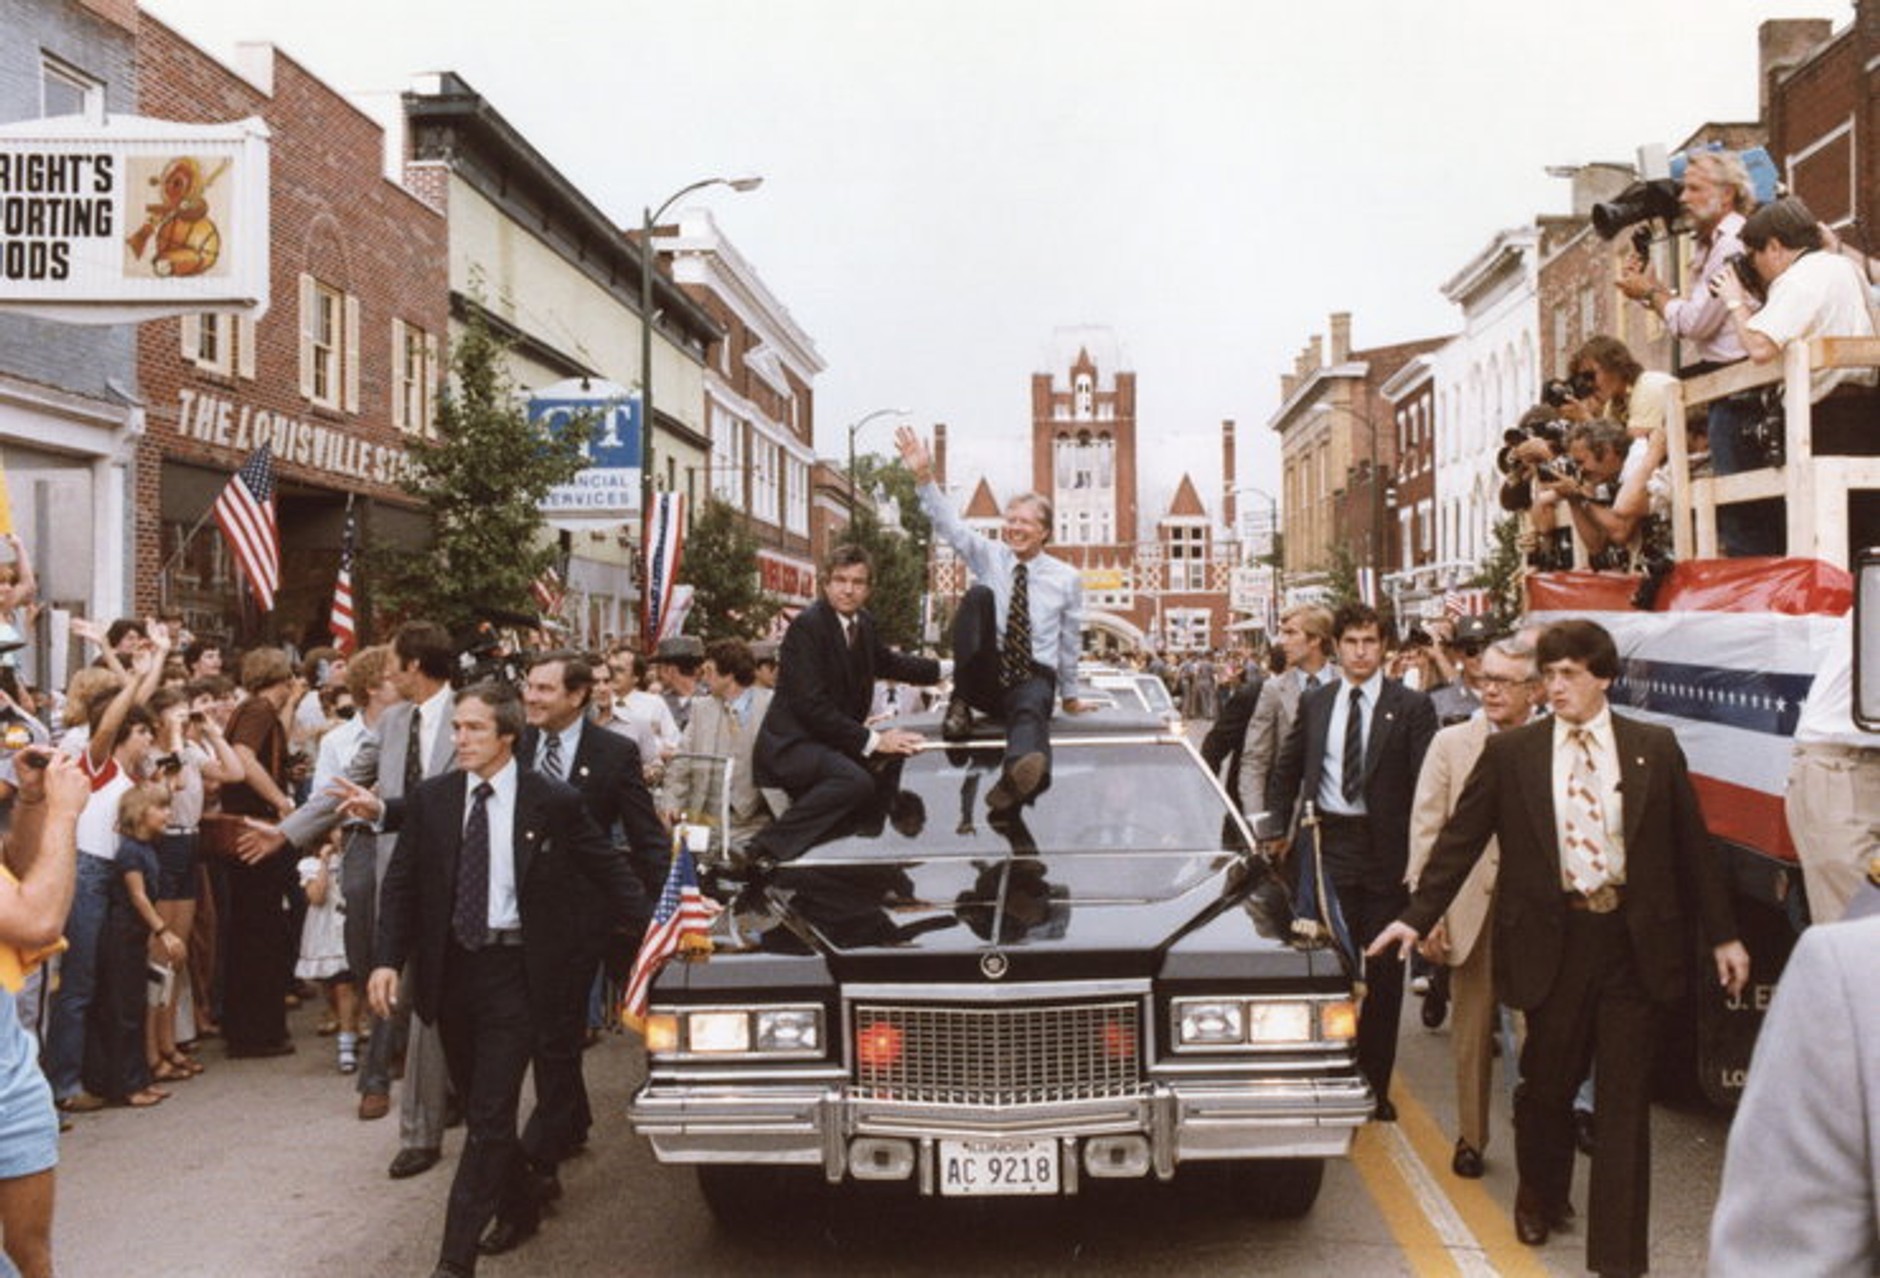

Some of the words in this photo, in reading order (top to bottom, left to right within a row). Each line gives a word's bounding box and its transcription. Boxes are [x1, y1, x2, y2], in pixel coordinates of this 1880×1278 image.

[0, 197, 113, 237] ORTING
[0, 241, 69, 280] ODS
[178, 388, 233, 446] THE
[236, 406, 372, 480] LOUISVILLE
[947, 1157, 977, 1184] AC
[988, 1156, 1051, 1184] 9218
